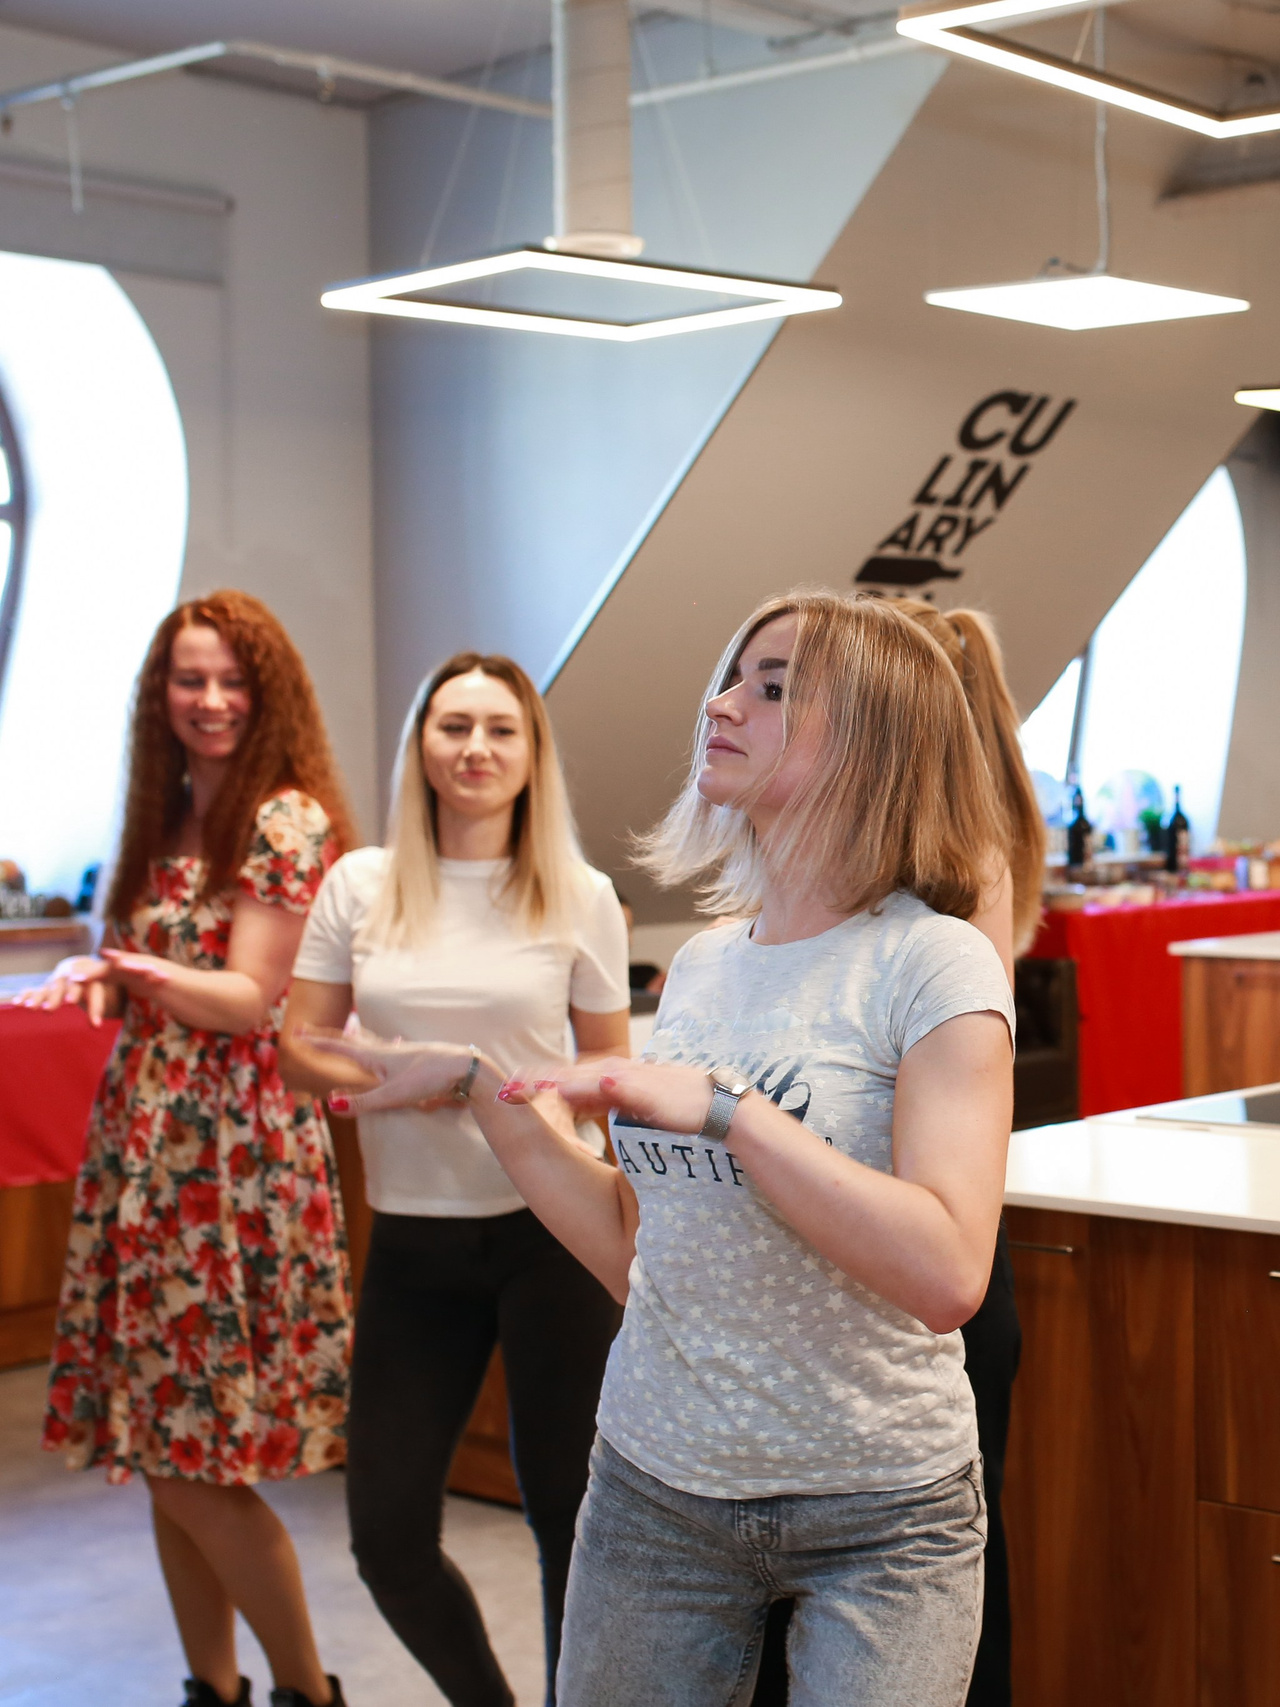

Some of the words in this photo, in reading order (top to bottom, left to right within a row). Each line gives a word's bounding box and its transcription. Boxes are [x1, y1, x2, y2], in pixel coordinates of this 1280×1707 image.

[957, 388, 1078, 457] CU
[911, 453, 1031, 512] LIN
[875, 510, 997, 557] ARY
